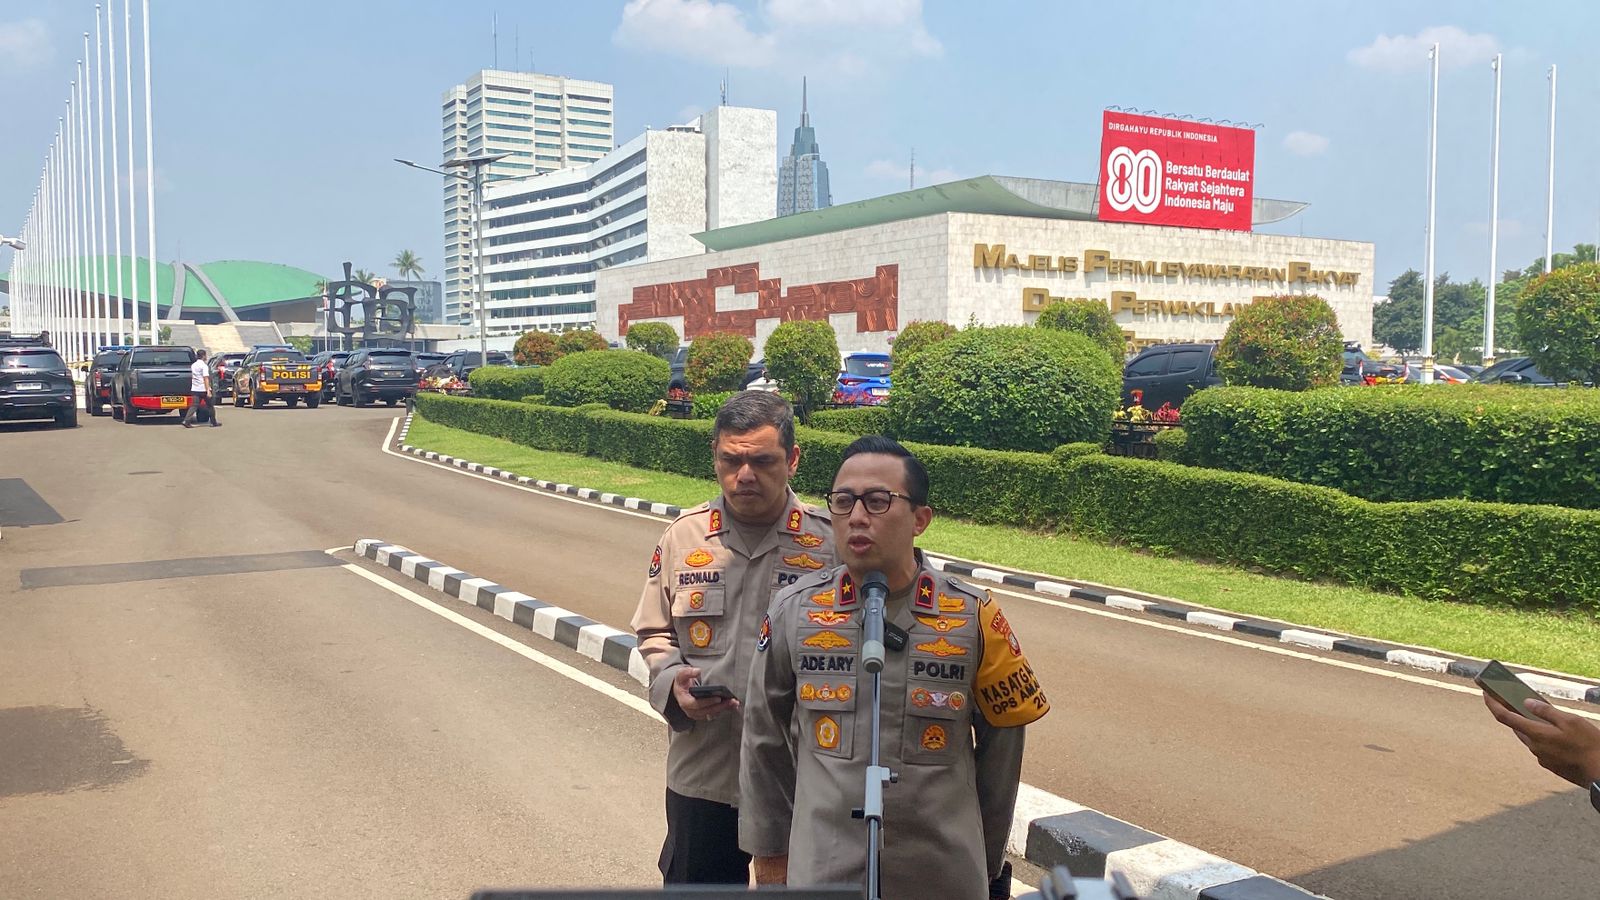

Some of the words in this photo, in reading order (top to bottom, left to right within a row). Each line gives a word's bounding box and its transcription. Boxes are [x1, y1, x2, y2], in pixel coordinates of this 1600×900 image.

[1108, 122, 1149, 135] DIRGAHAYU
[1149, 127, 1182, 138] REPUBLIK
[1183, 131, 1218, 143] INDONESIA
[1106, 146, 1163, 214] 80
[1166, 160, 1204, 176] Bersatu
[1205, 165, 1250, 182] Berdaulat
[1165, 178, 1199, 195] Rakyat
[1200, 180, 1245, 197] Sejahtera
[1164, 194, 1211, 210] Indonesia
[1212, 198, 1235, 215] Maju
[273, 371, 311, 379] POLISI
[678, 571, 720, 585] REONALD
[800, 655, 825, 671] ADE
[826, 655, 854, 672] ARY
[913, 660, 965, 681] POLRI
[992, 696, 1018, 715] OPS
